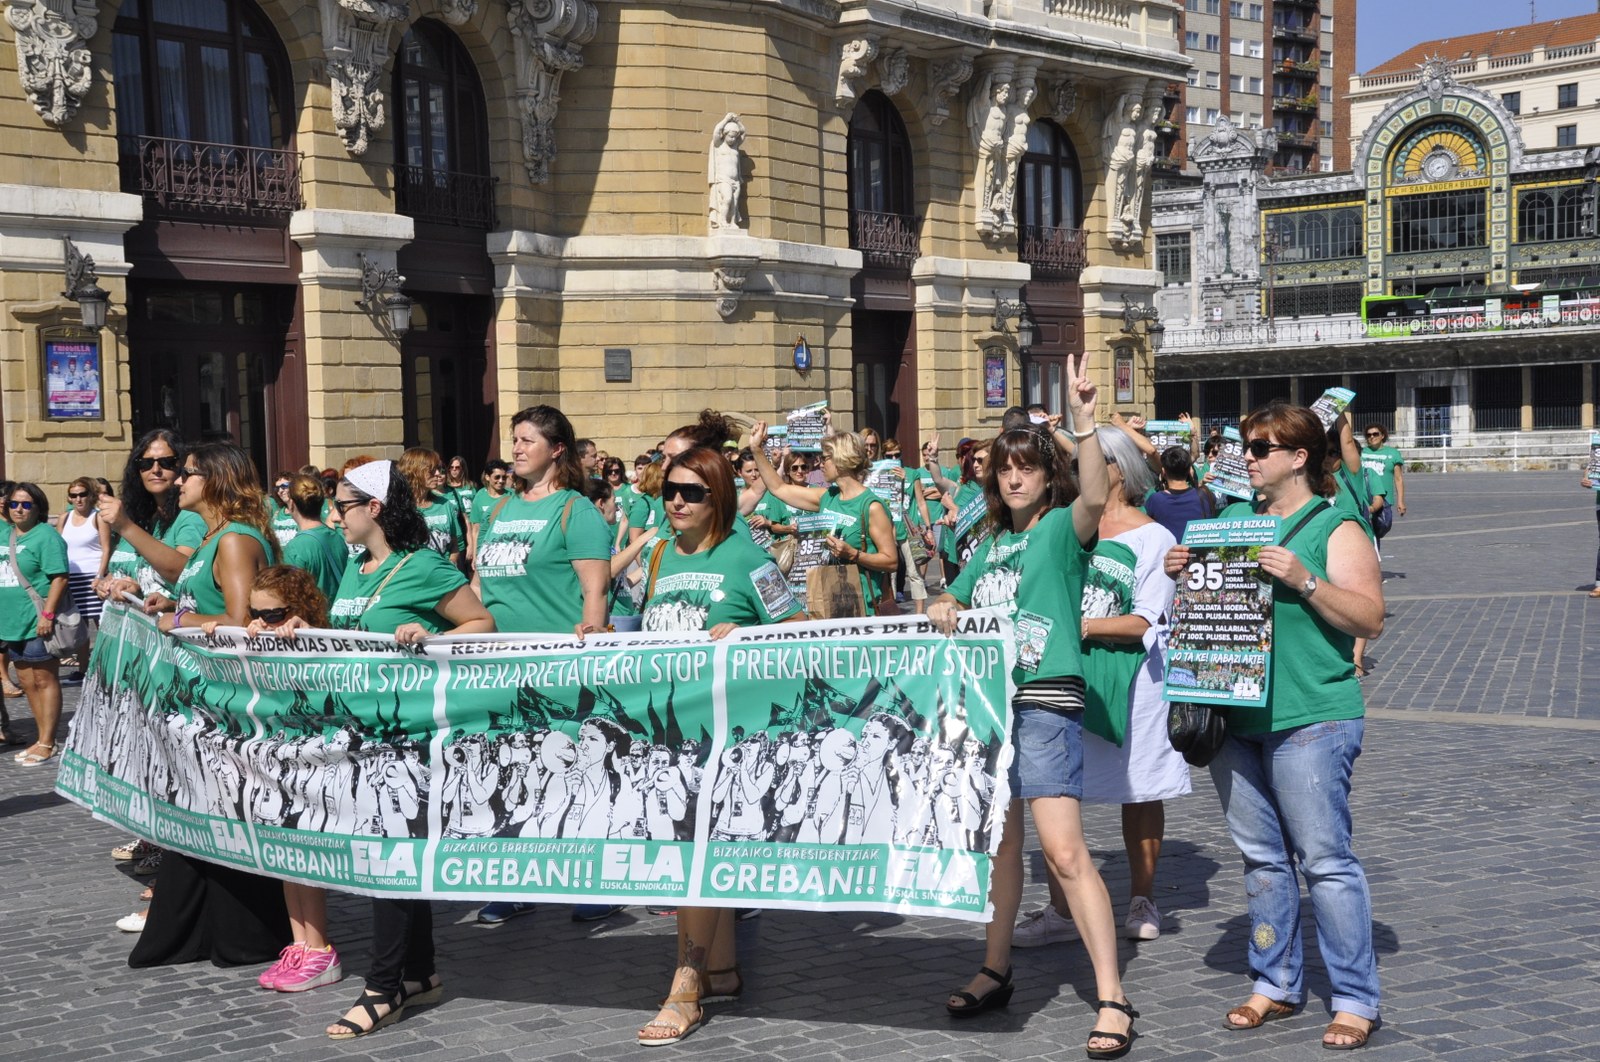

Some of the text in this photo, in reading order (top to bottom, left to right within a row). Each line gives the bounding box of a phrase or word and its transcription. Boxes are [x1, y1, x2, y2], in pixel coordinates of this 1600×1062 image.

[1409, 183, 1455, 193] SANTANDER
[1460, 179, 1489, 187] BILBAO
[766, 438, 781, 447] 35
[1150, 435, 1167, 446] 35
[1224, 442, 1243, 456] 35
[1187, 519, 1276, 532] RESIDENCIAS DE BIZKAIA
[800, 540, 814, 556] 35
[694, 574, 722, 582] BIZKAIA
[1187, 562, 1224, 590] 35
[882, 622, 910, 634] DE
[915, 616, 1001, 634] BIKAIA
[243, 636, 328, 653] RESIDENCIAS
[331, 638, 353, 653] DE
[732, 644, 999, 680] PREKARIETATEARI STOP
[1170, 652, 1265, 664] JO TA KE! IRABAZI ARTE!
[251, 660, 433, 693] PREKARIETATEARI STOP
[451, 650, 708, 690] PREKARIETATEARI STOP
[1233, 682, 1260, 698] ELA
[156, 816, 253, 857] GREBAN!! ELA
[258, 828, 346, 849] BIZKAIKO ERRESIDENTZIAK
[442, 842, 596, 855] BIZKAIKO ERRESIDENTZIAK
[713, 847, 880, 861] BIZKAIKO ERRESIDENTZIAK
[262, 839, 418, 881] GREBAN!! ELA
[440, 843, 685, 889] GREBAN!! ELA
[710, 848, 980, 895] GREBAN!! ELA
[354, 874, 418, 886] EUSKAL SINDIKATUA
[600, 881, 684, 892] EUSKAL SINDIKATUA
